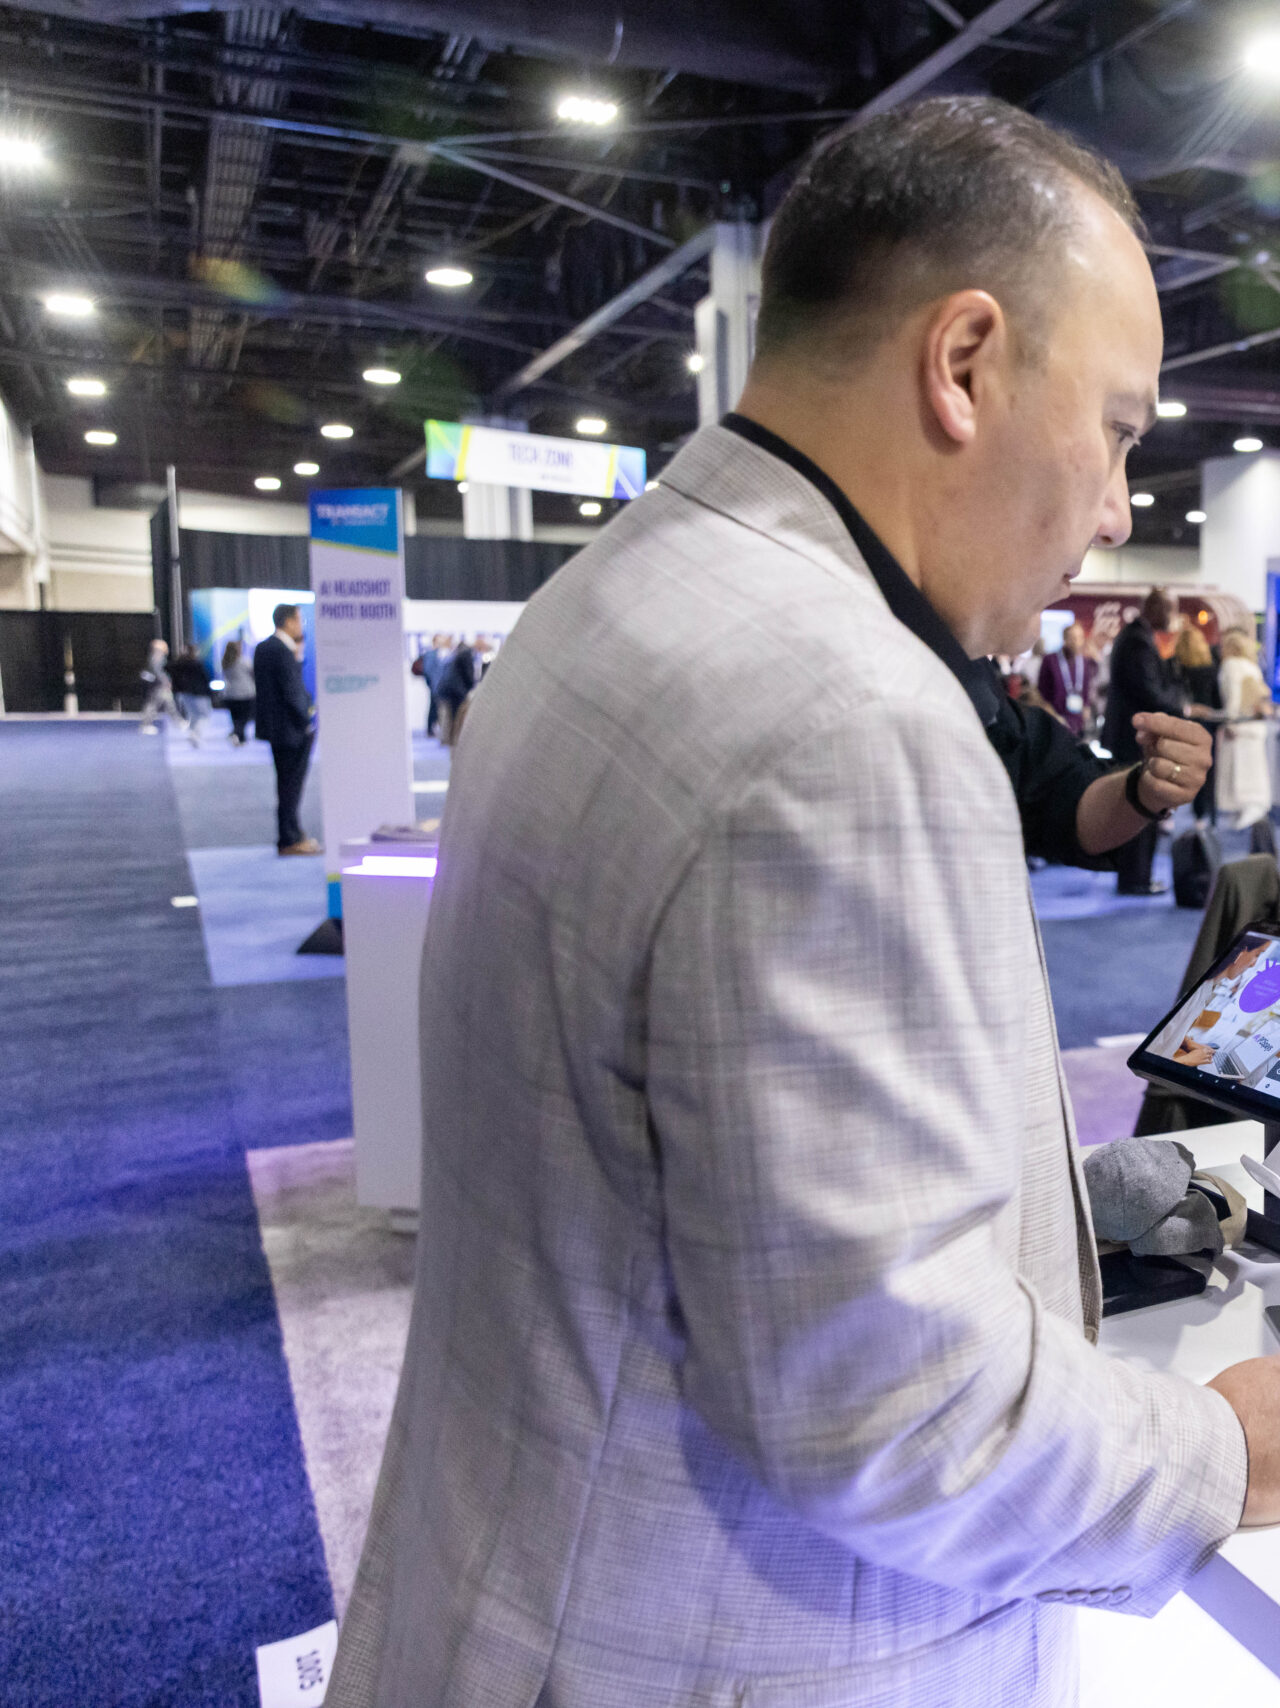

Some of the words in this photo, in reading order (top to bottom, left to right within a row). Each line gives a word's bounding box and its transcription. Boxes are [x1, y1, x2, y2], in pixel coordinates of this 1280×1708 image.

[334, 578, 391, 597] HEADSHOT
[320, 603, 356, 619] PHOTO
[360, 603, 397, 620] BOOTH
